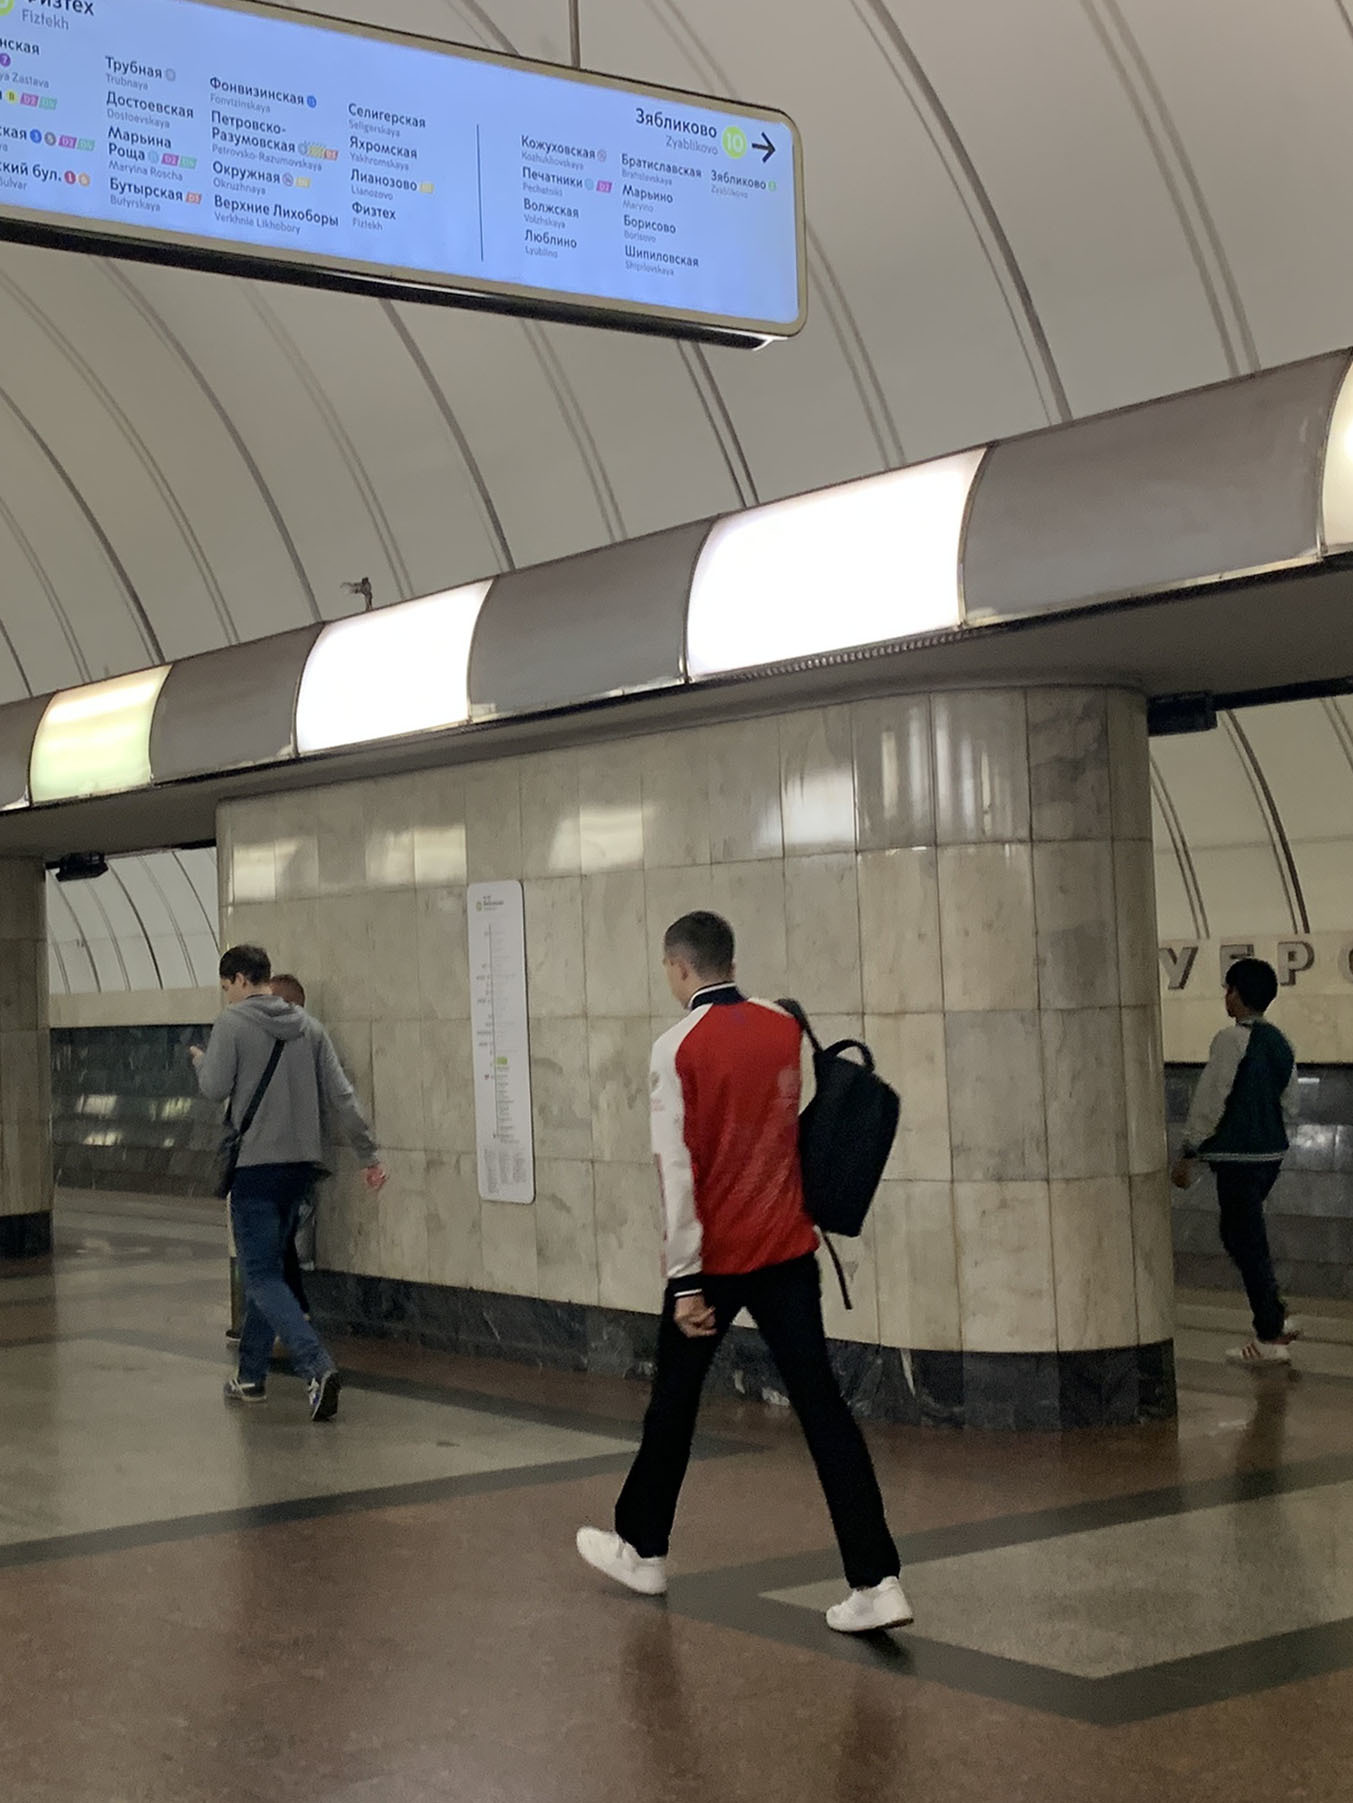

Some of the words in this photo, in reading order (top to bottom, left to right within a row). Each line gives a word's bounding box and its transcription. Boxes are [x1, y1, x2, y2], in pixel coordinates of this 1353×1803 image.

[22, 9, 69, 30] Fiztekh
[105, 56, 162, 78] Трубная
[12, 73, 49, 88] Zastava
[106, 74, 148, 90] Trubnaya
[210, 76, 304, 105] Фонвизинская
[106, 91, 194, 118] Достоевская
[107, 109, 170, 129] Dostoevskaya
[211, 110, 286, 134] Петровско-
[348, 103, 426, 128] Селигерская
[635, 107, 717, 139] Зябликово
[108, 126, 172, 149] Марьина
[212, 127, 296, 152] Разумовская
[350, 136, 417, 159] Яхромская
[521, 135, 596, 159] Кожуховская
[665, 135, 719, 155] Zyablikovo
[109, 142, 145, 161] Роща
[32, 163, 61, 182] бул.
[109, 160, 147, 174] Maryina
[150, 166, 183, 181] Roscha
[213, 161, 280, 184] Окружная
[621, 153, 702, 178] Братиславская
[213, 177, 266, 195] Okruzhnaya
[350, 168, 417, 191] Лианозово
[522, 166, 583, 188] Печатники
[711, 170, 766, 190] Зябликово
[110, 177, 183, 201] Бутырская
[351, 186, 394, 201] Lianozovo
[622, 184, 673, 203] Марьино
[110, 195, 161, 212] Butyrskaya
[214, 194, 270, 216] Верхние
[273, 204, 339, 227] Лихоборы
[352, 201, 397, 220] Физтех
[523, 198, 579, 218] Волжская
[257, 218, 301, 234] Likhobory
[352, 217, 383, 231] Fiztekh
[624, 215, 676, 234] Борисово
[525, 229, 577, 248] Люблино
[625, 245, 699, 267] Шипиловская
